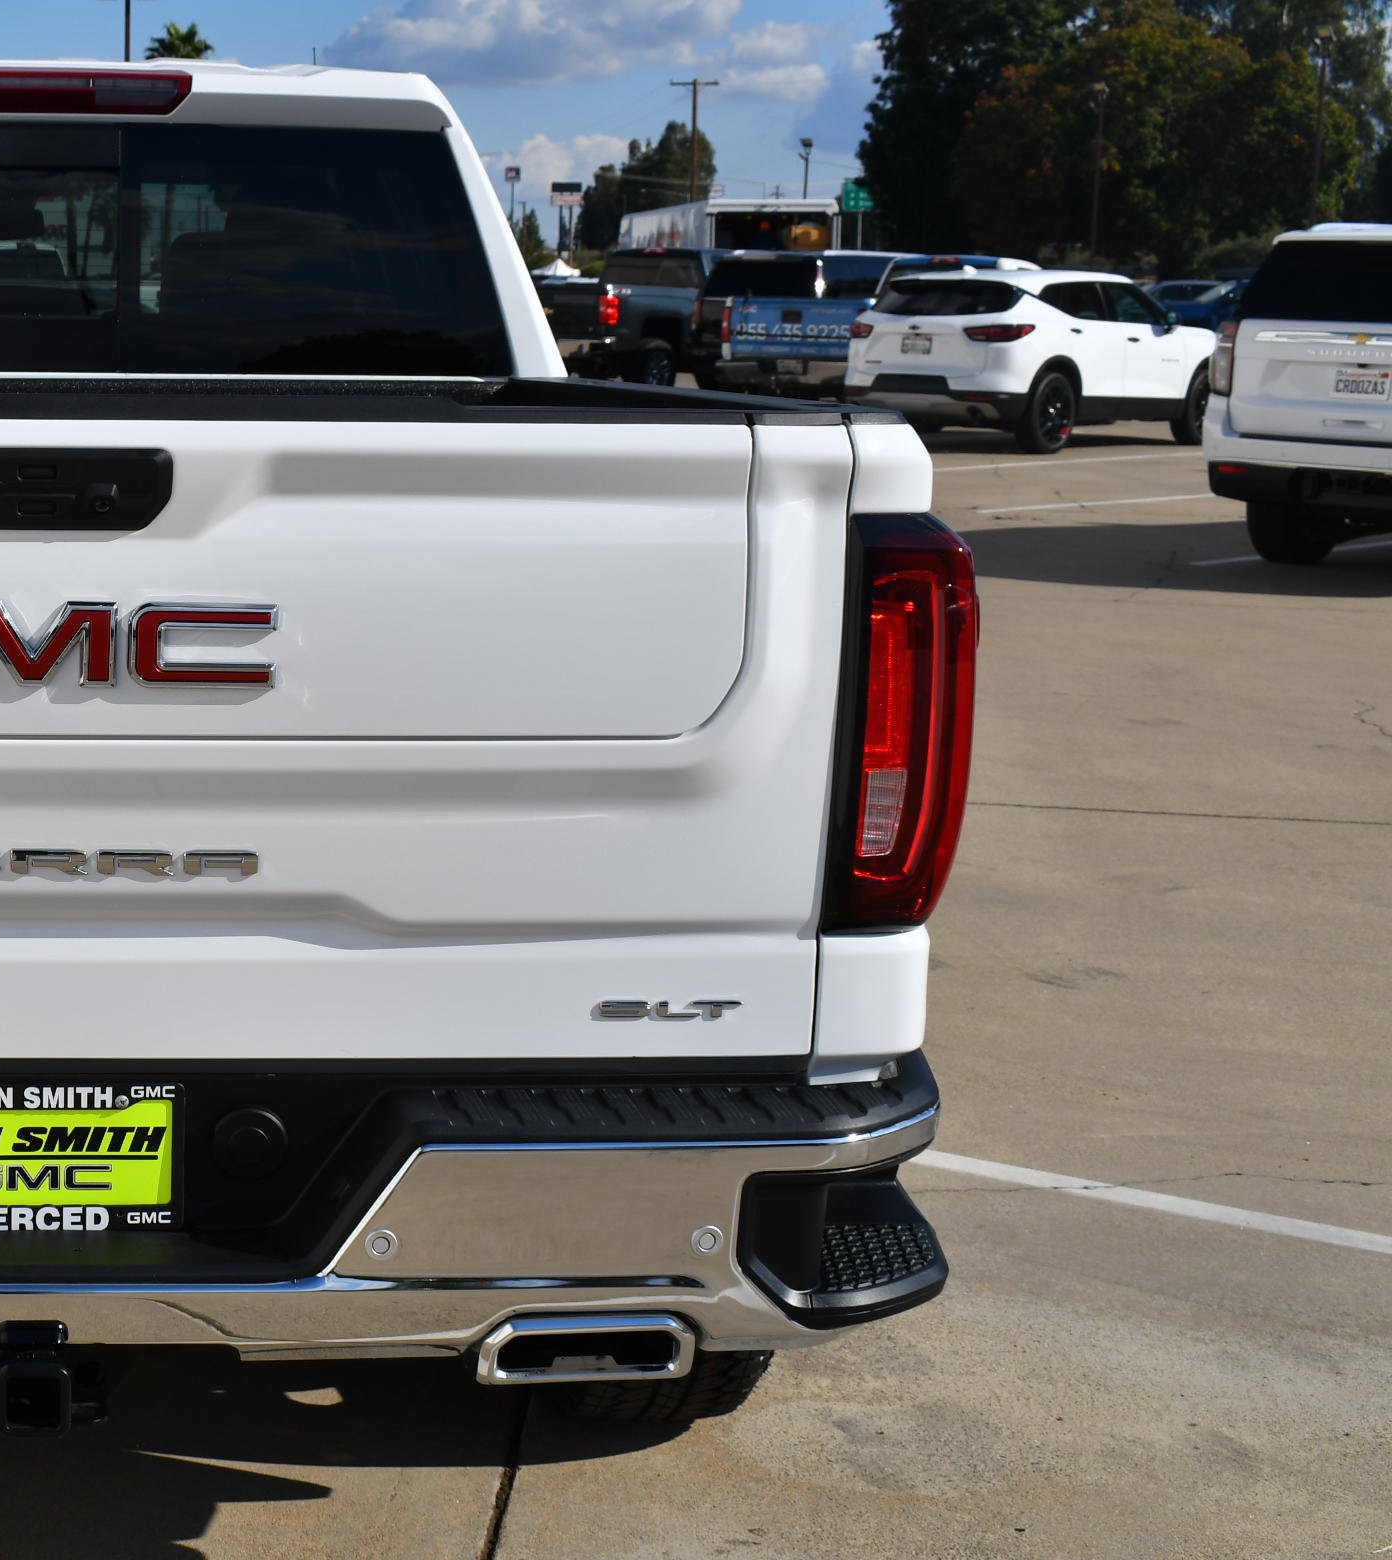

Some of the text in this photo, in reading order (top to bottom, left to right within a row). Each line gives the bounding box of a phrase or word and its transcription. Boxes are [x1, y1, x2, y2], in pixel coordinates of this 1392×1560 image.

[599, 999, 745, 1017] SLT
[23, 1086, 113, 1109] SMITH
[130, 1085, 176, 1099] GMC
[11, 1126, 167, 1153] SMITH
[126, 1211, 172, 1225] GMC
